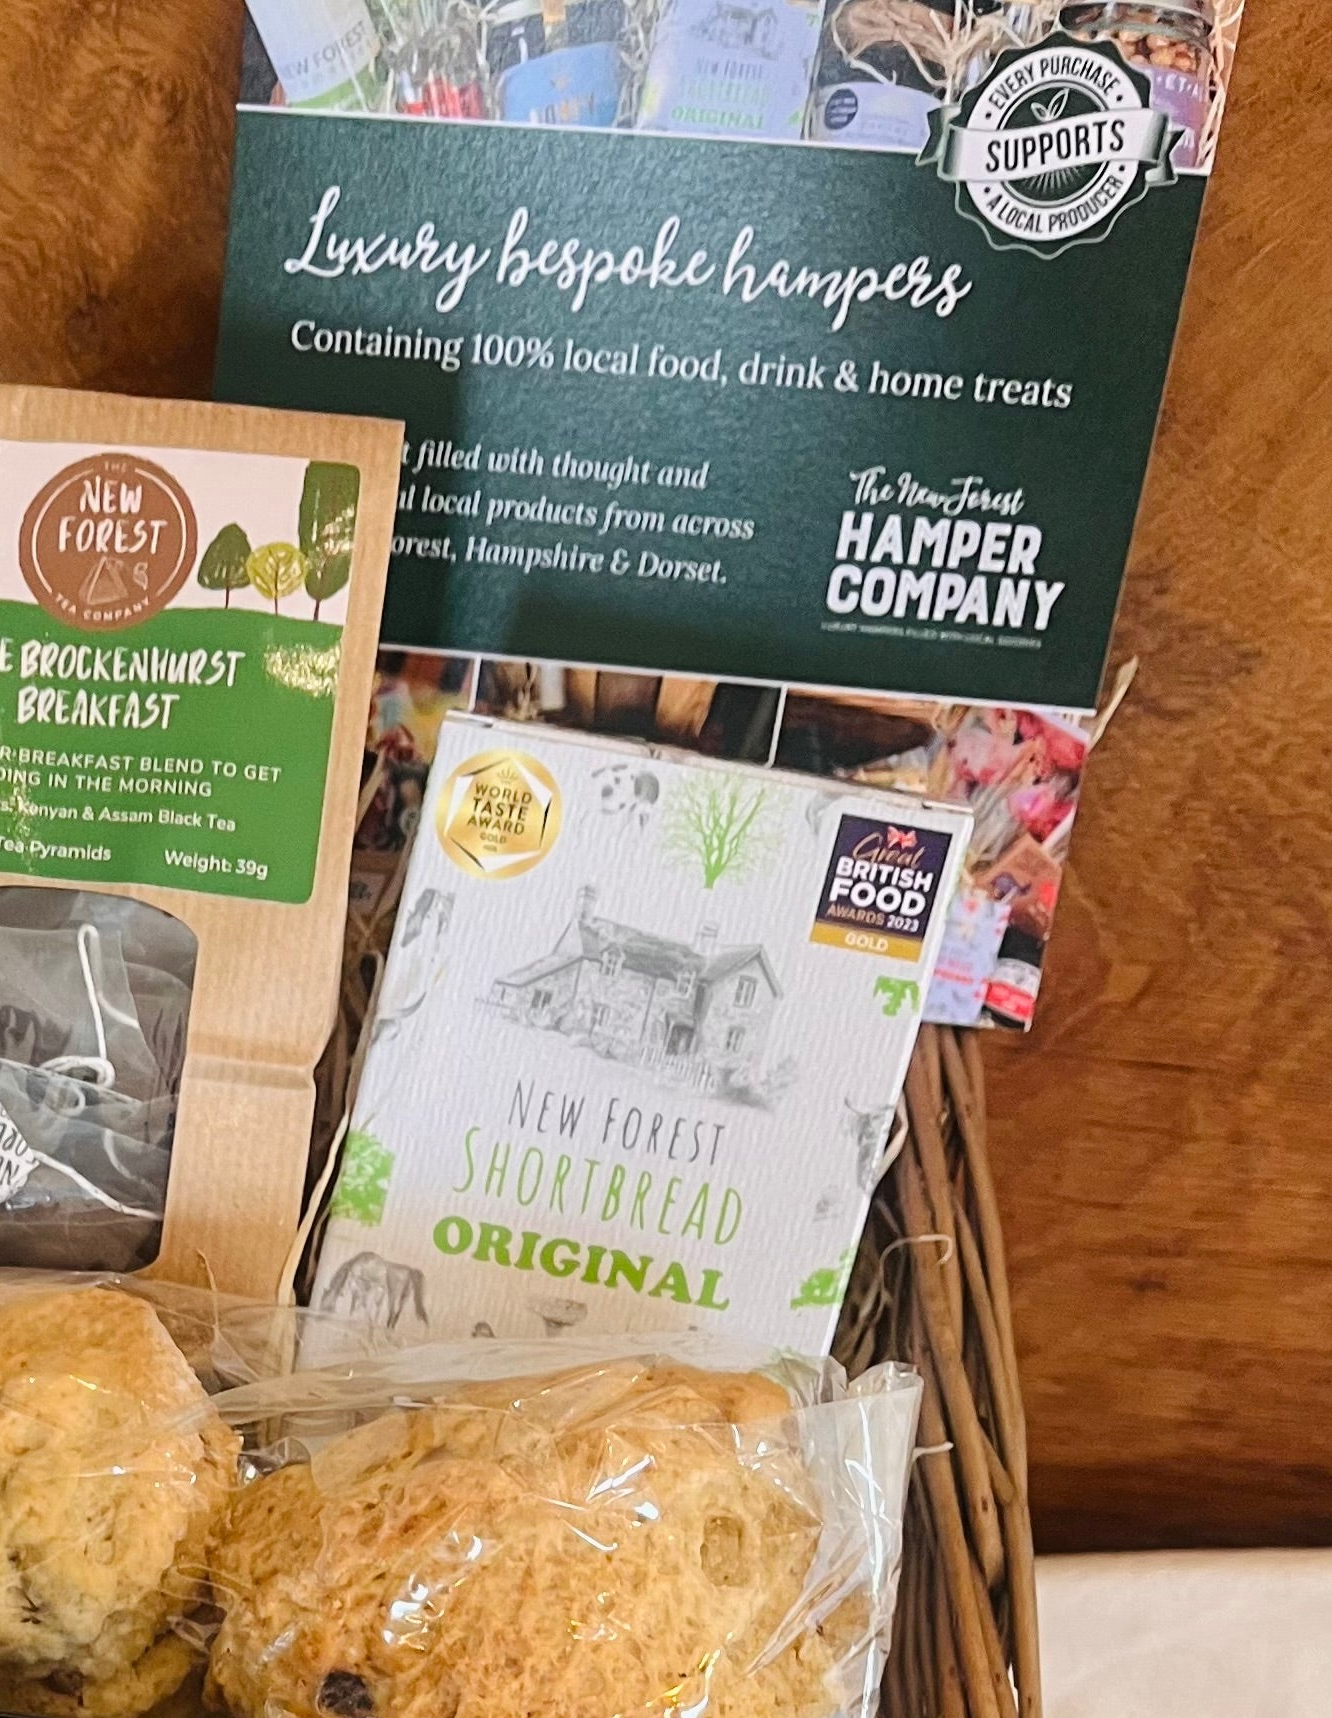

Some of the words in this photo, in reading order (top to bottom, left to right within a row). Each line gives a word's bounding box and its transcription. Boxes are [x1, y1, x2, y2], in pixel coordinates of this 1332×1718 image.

[991, 65, 1035, 110] EVERY
[1040, 56, 1121, 96] PURCHASE
[985, 118, 1125, 175] SUPPORTS
[986, 195, 998, 211] A
[997, 201, 1043, 232] LOCAL
[1048, 176, 1124, 232] PRODUCER
[284, 186, 491, 313] Luxury
[496, 206, 715, 312] bespoke
[723, 226, 972, 332] hampers
[291, 320, 465, 372] Containing
[471, 333, 555, 369] 100%
[563, 339, 639, 375] local
[647, 345, 728, 387] food,
[738, 351, 827, 391] drink
[835, 360, 859, 392] &
[869, 361, 964, 399] home
[973, 373, 1073, 408] treats
[412, 440, 481, 474] filled
[487, 447, 544, 476] with
[551, 451, 651, 489] thought
[657, 461, 710, 489] and
[79, 475, 143, 514] NEW
[850, 465, 895, 506] The
[897, 472, 948, 510] New
[943, 475, 1025, 516] Forest
[422, 485, 481, 515] local
[486, 495, 598, 526] products
[598, 502, 665, 536] from
[672, 514, 755, 540] across
[58, 515, 168, 555] FOREST
[835, 510, 1043, 575] HAMPER
[465, 536, 605, 574] Hampshire
[638, 550, 727, 584] Dorset.
[55, 592, 77, 615] TEA
[84, 596, 150, 622] COMPANY
[825, 563, 1066, 631] COMPANY
[20, 640, 246, 687] BROCKENHURST
[17, 684, 180, 731] BREAKFAST
[19, 748, 134, 772] BREAKFAST
[140, 757, 204, 774] BLEND
[211, 760, 237, 777] TO
[244, 764, 283, 784] GET
[48, 773, 69, 790] IN
[75, 775, 112, 792] THE
[118, 777, 212, 798] MORNING
[473, 796, 529, 822] TASTE
[475, 782, 532, 804] WORLD
[82, 806, 94, 821] &
[98, 806, 153, 824] Assam
[158, 808, 202, 828] Black
[206, 813, 236, 832] Tea
[467, 815, 525, 836] AWARD
[29, 840, 111, 861] Pyramids
[164, 849, 232, 873] Weight:
[235, 858, 269, 881] 39g
[852, 832, 926, 870] Great
[835, 855, 934, 893] BRITISH
[826, 904, 886, 926] AWARDS
[829, 877, 927, 917] FOOD
[844, 931, 889, 952] GOLD
[506, 1077, 584, 1139] NEW
[601, 1098, 726, 1166] FOREST
[453, 1125, 743, 1247] SHORTBREAD
[432, 1215, 731, 1312] ORIGINAL
